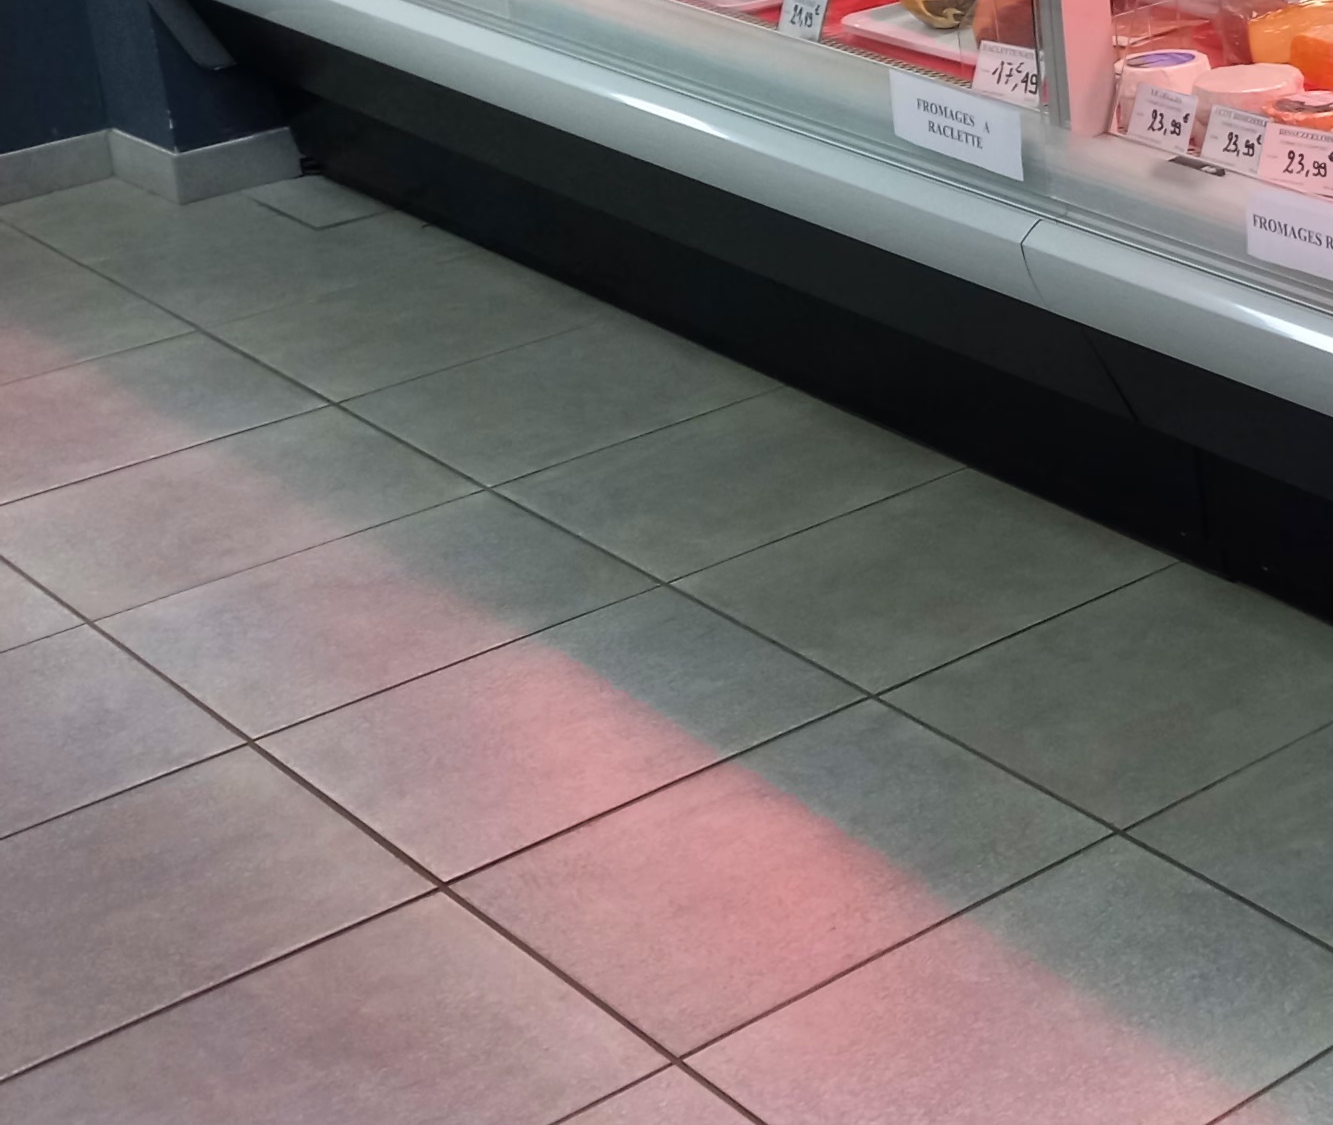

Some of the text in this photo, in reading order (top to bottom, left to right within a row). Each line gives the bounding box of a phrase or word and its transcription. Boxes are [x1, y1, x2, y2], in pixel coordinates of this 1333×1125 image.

[916, 98, 990, 134] FROMAGES A
[928, 120, 983, 150] RACLETTE
[1251, 213, 1323, 247] FROMAGES
